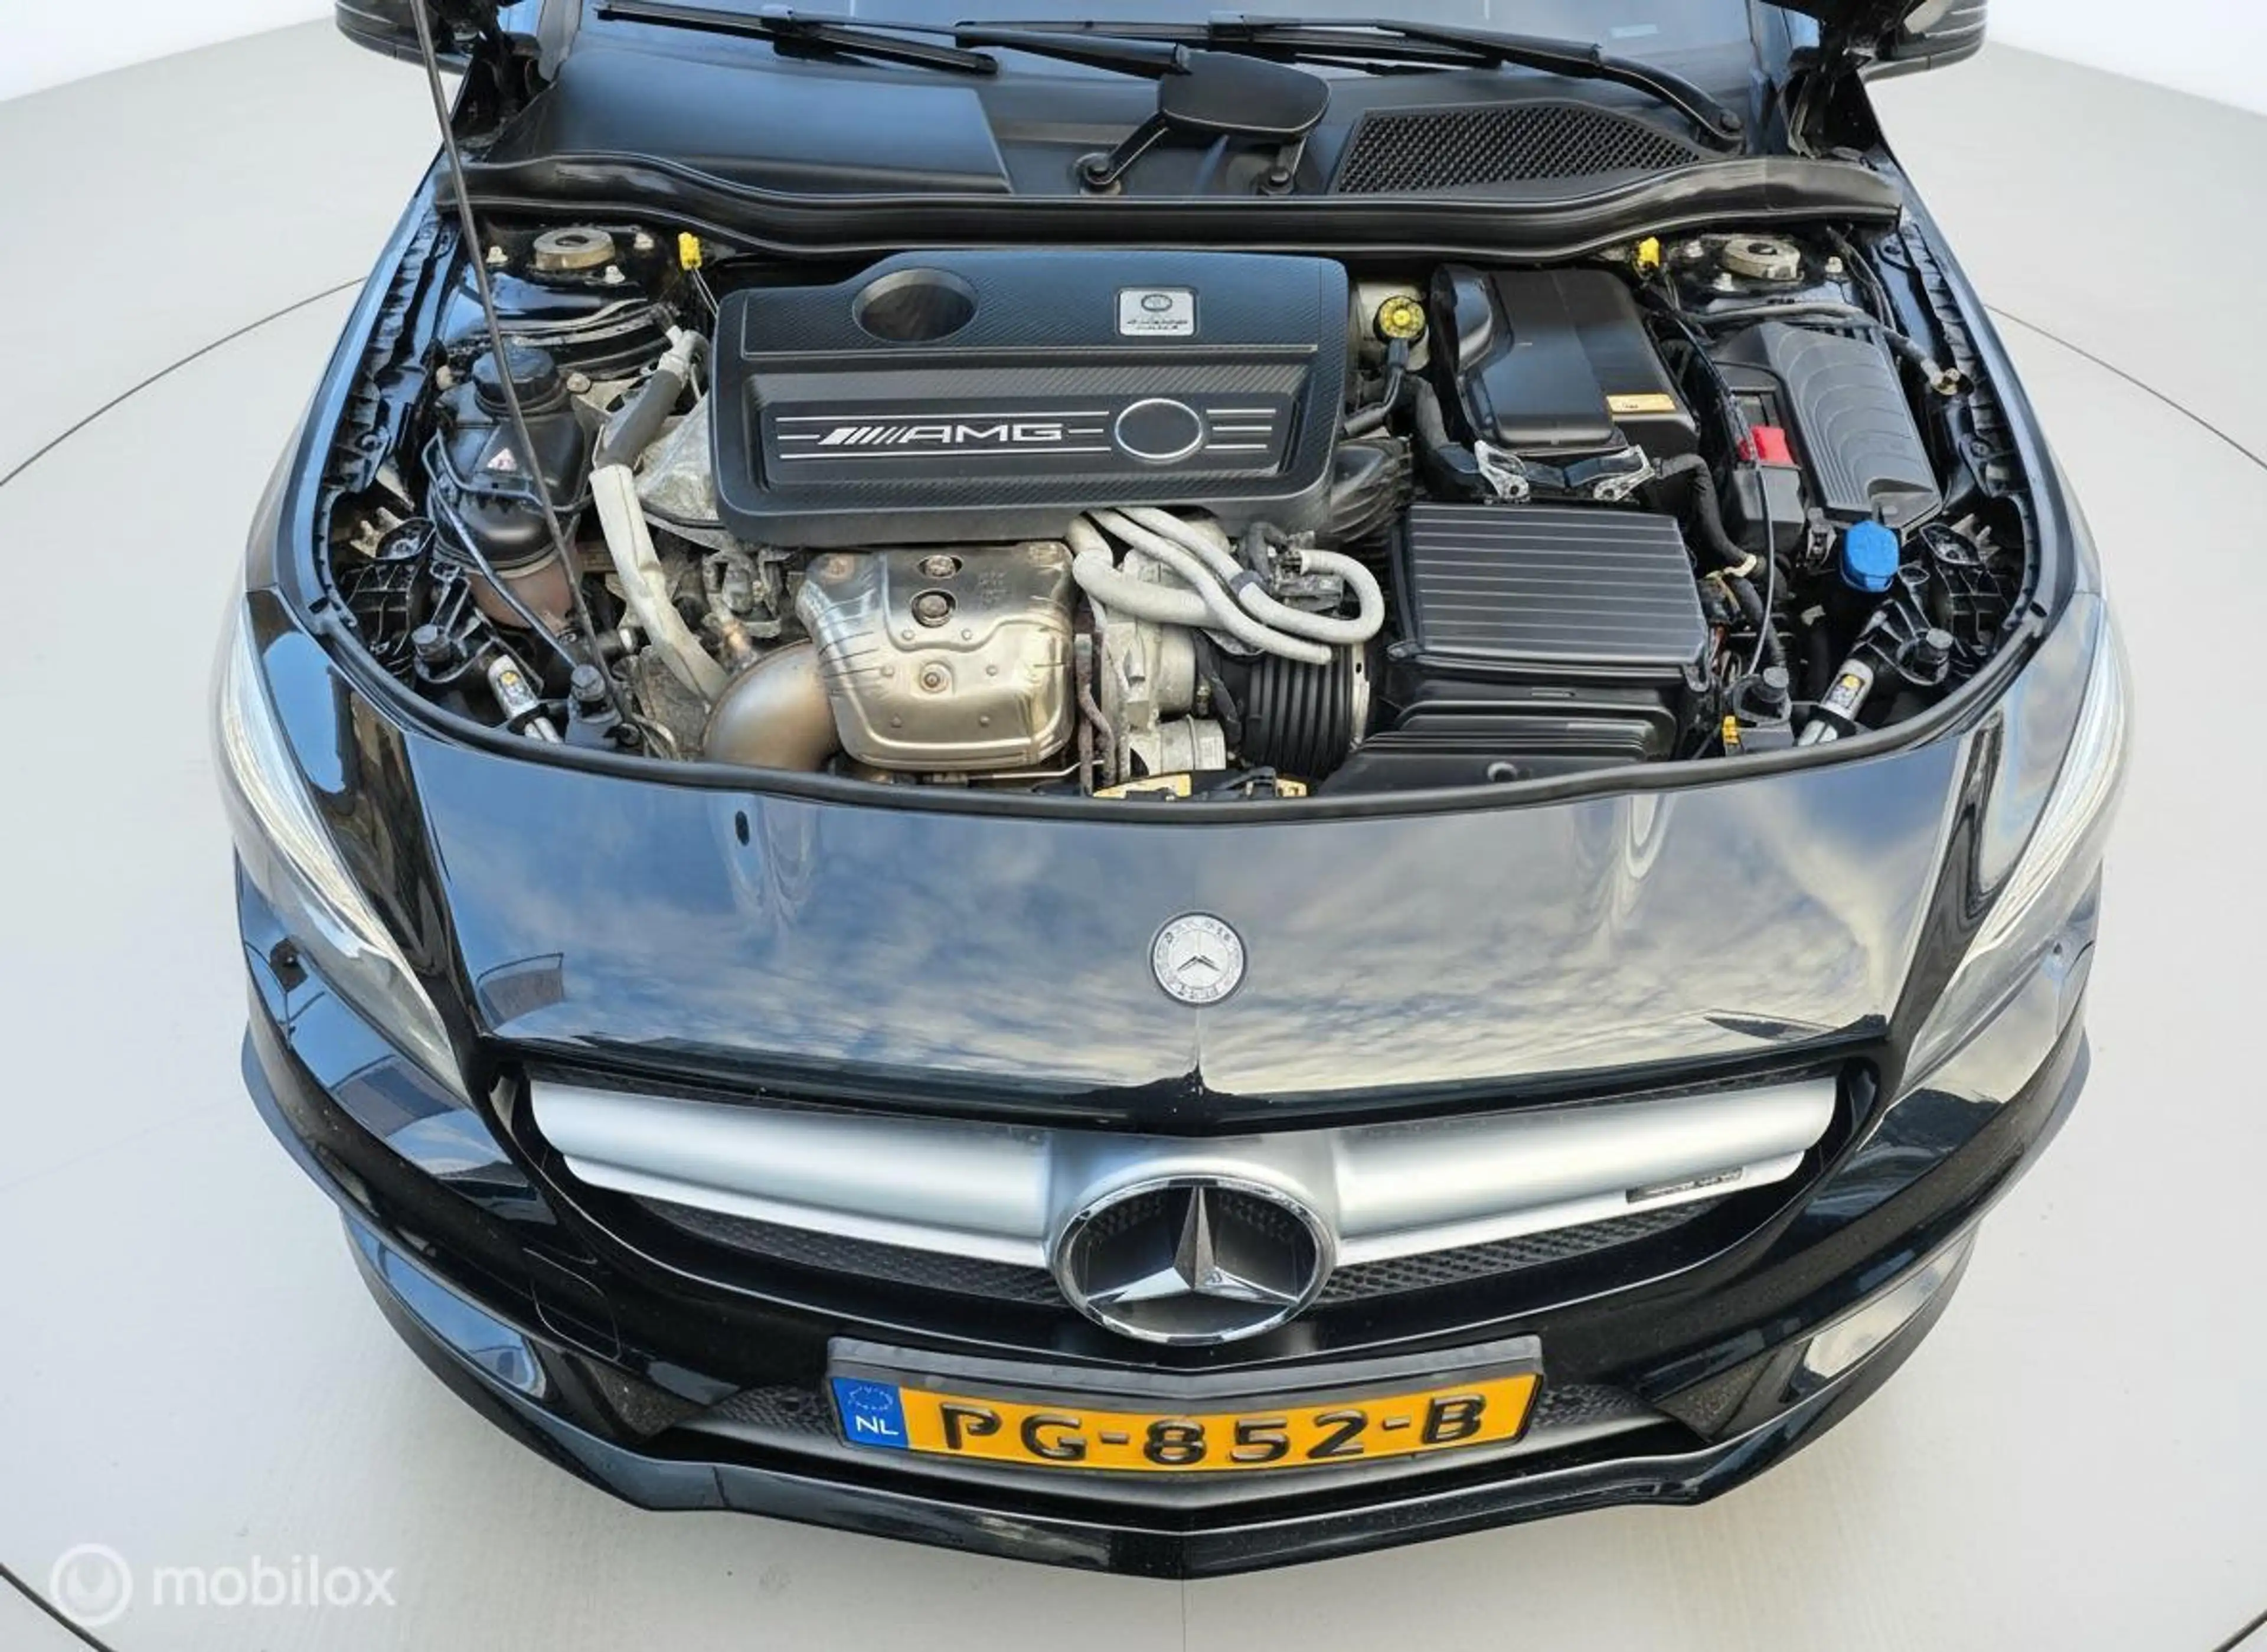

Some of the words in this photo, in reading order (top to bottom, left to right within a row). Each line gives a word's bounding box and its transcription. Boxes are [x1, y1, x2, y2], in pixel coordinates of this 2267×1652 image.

[897, 423, 1063, 443] AMG
[855, 1415, 900, 1436] NL
[939, 1394, 1486, 1465] PG-852-B
